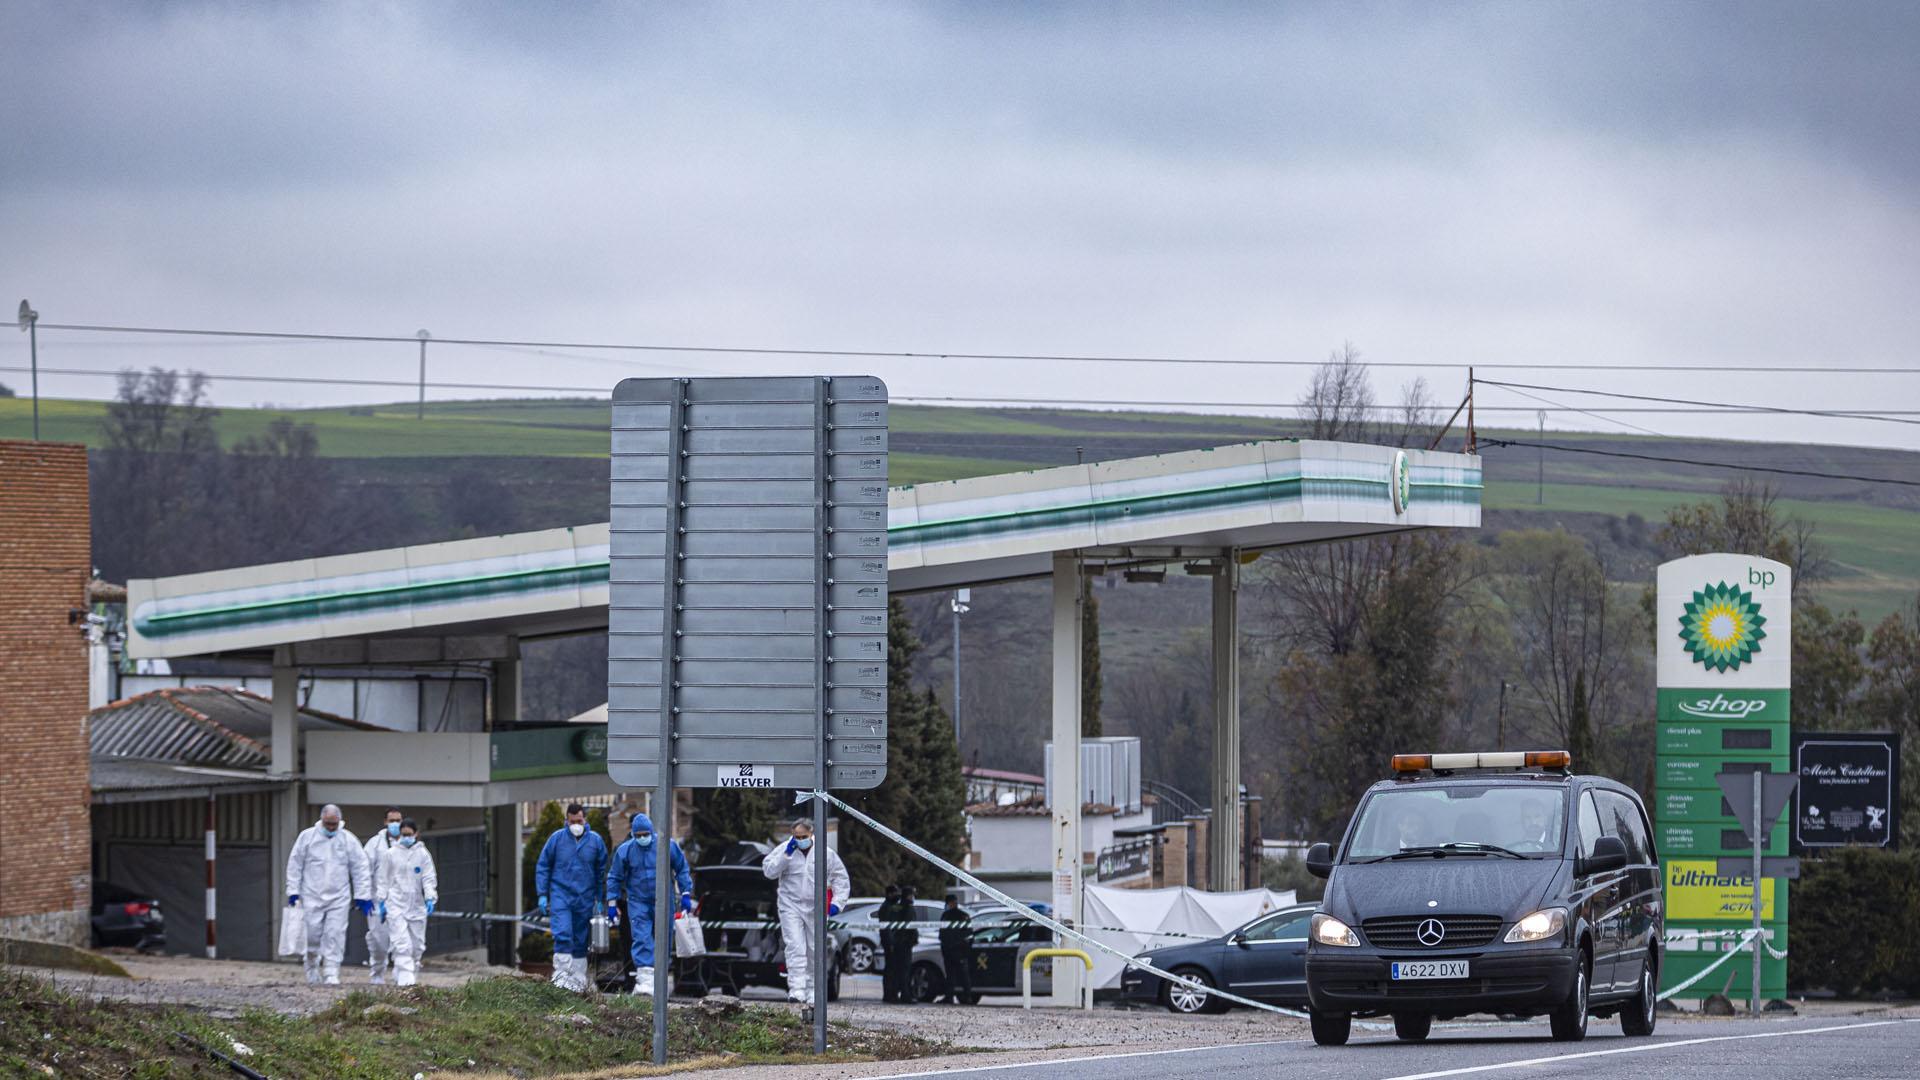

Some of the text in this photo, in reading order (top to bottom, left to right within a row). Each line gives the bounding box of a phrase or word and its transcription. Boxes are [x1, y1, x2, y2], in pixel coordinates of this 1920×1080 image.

[1749, 567, 1775, 589] bp
[1679, 694, 1766, 718] shop
[1840, 763, 1886, 776] Castellano
[721, 778, 771, 787] VISEVER
[1672, 865, 1682, 874] bp
[1672, 870, 1753, 887] ultimate
[1401, 963, 1466, 977] 4622 DXV
